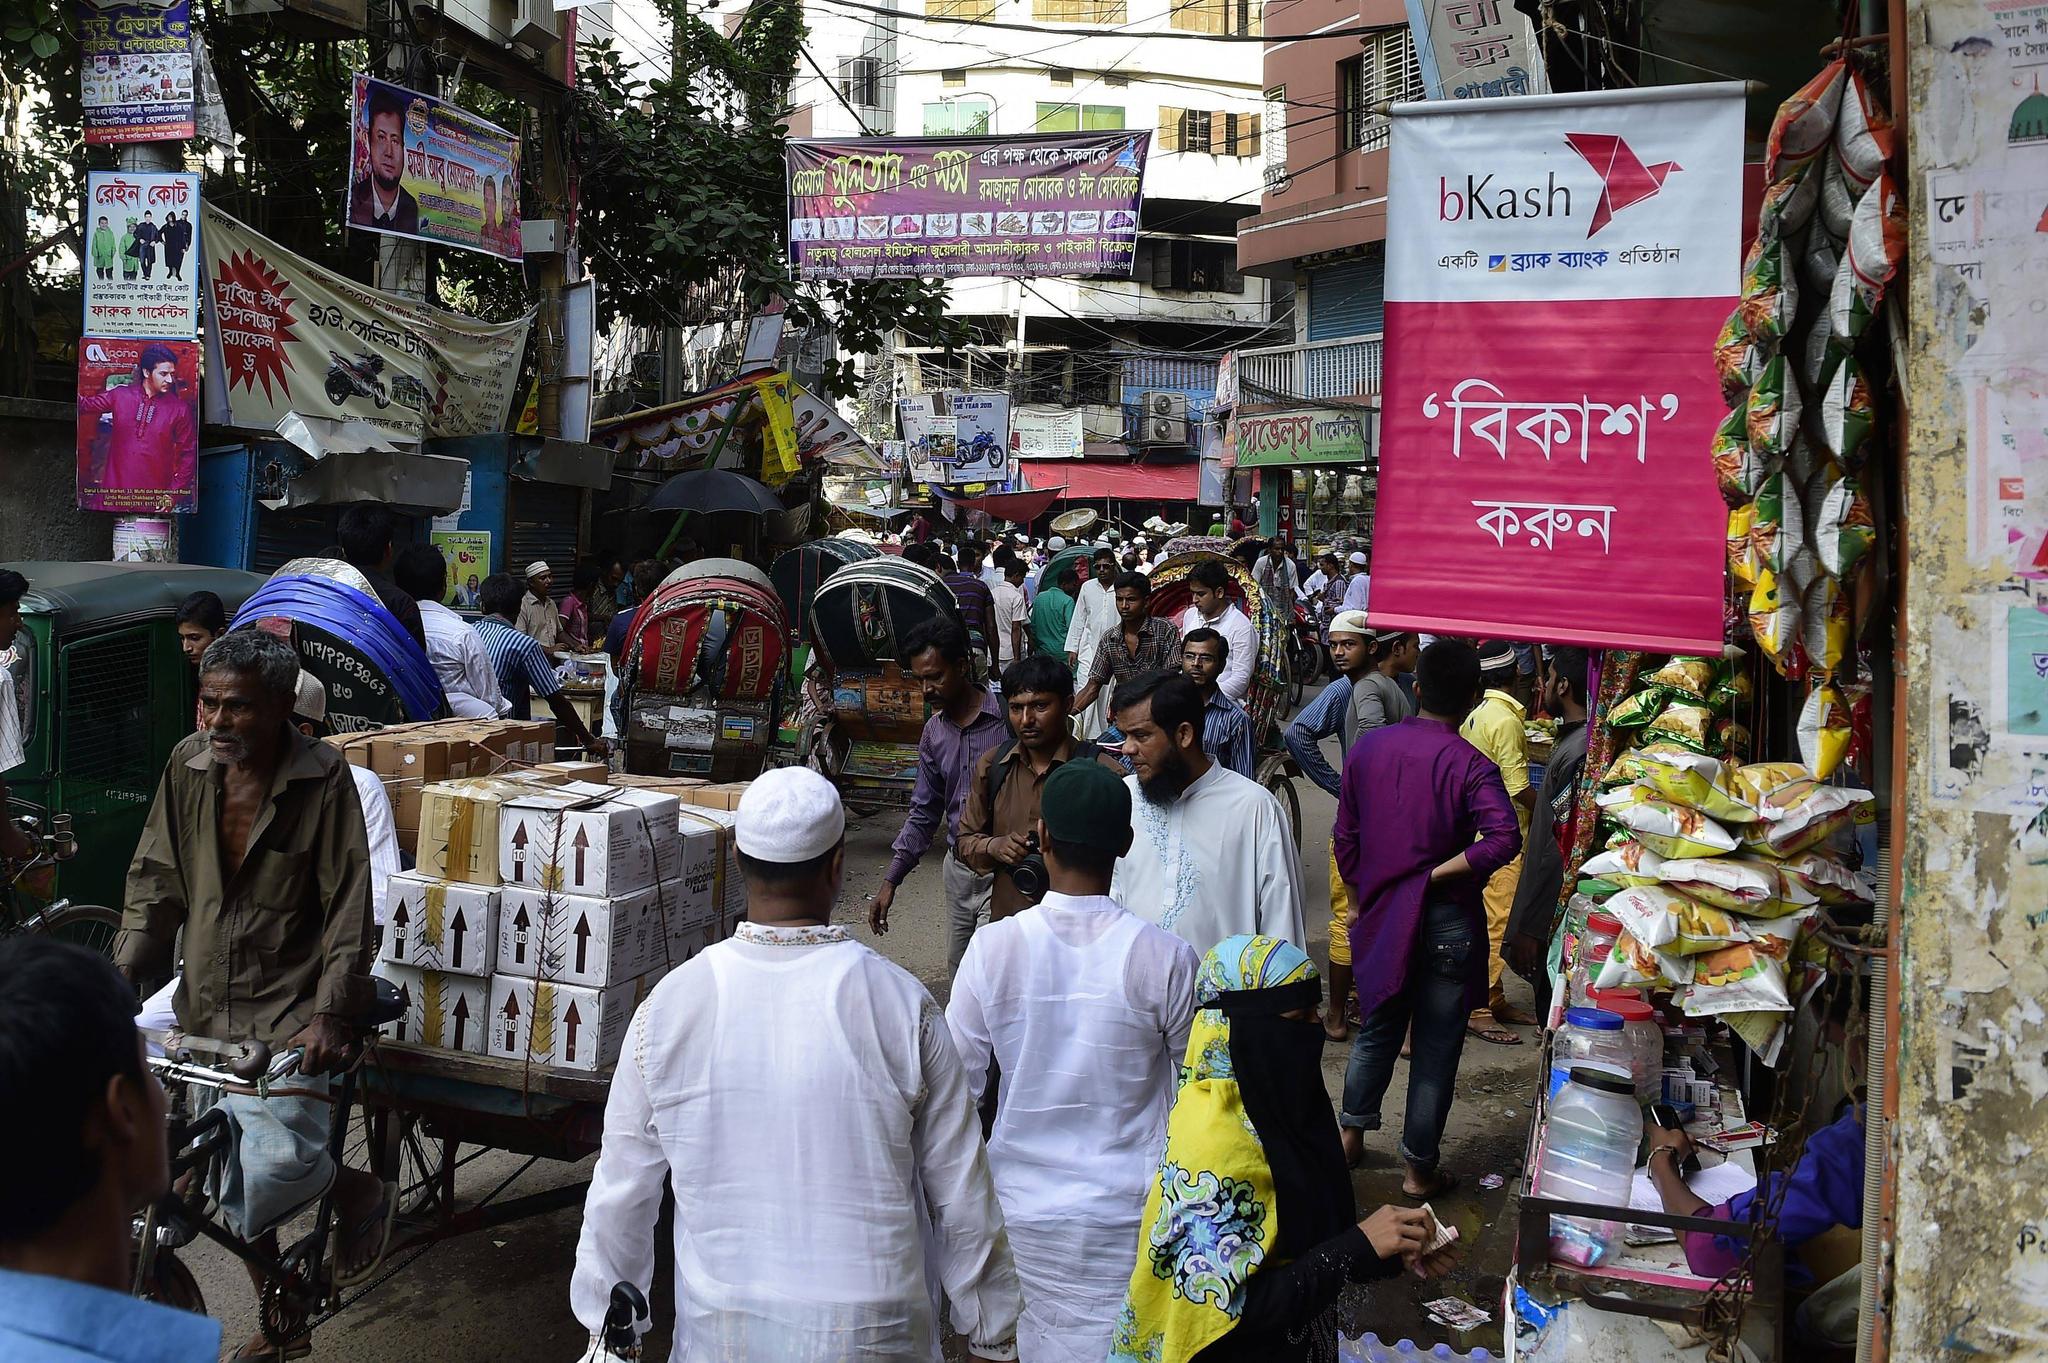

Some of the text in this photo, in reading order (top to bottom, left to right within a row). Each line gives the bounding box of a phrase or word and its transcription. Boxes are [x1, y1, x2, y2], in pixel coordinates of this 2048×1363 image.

[980, 146, 1110, 167] এর পক্ষ থেকে সকলকে
[95, 177, 191, 209] রেইন কোট
[832, 149, 904, 212] সুলতান
[1023, 175, 1065, 201] মোবারক
[1067, 177, 1076, 198] ও
[1098, 174, 1140, 202] মোবারক
[1439, 171, 1572, 222] bKash
[840, 245, 882, 260] হোলসেল
[884, 242, 927, 259] ইমিটেশন
[973, 239, 1040, 257] আমদানীকারক
[1043, 242, 1052, 255] ও
[1055, 238, 1097, 256] পাইকারী
[1438, 243, 1682, 272] একটি ব্র্যাক ব্যাংক প্রতিষ্ঠান
[218, 280, 257, 307] পবিত্র
[260, 288, 284, 313] ঈদ
[90, 302, 190, 320] ফারুক গার্মেন্টস
[1471, 499, 1618, 556] করুন
[513, 850, 526, 862] 10
[394, 927, 407, 939] 10
[515, 932, 527, 943] 10
[505, 1020, 518, 1031] 10
